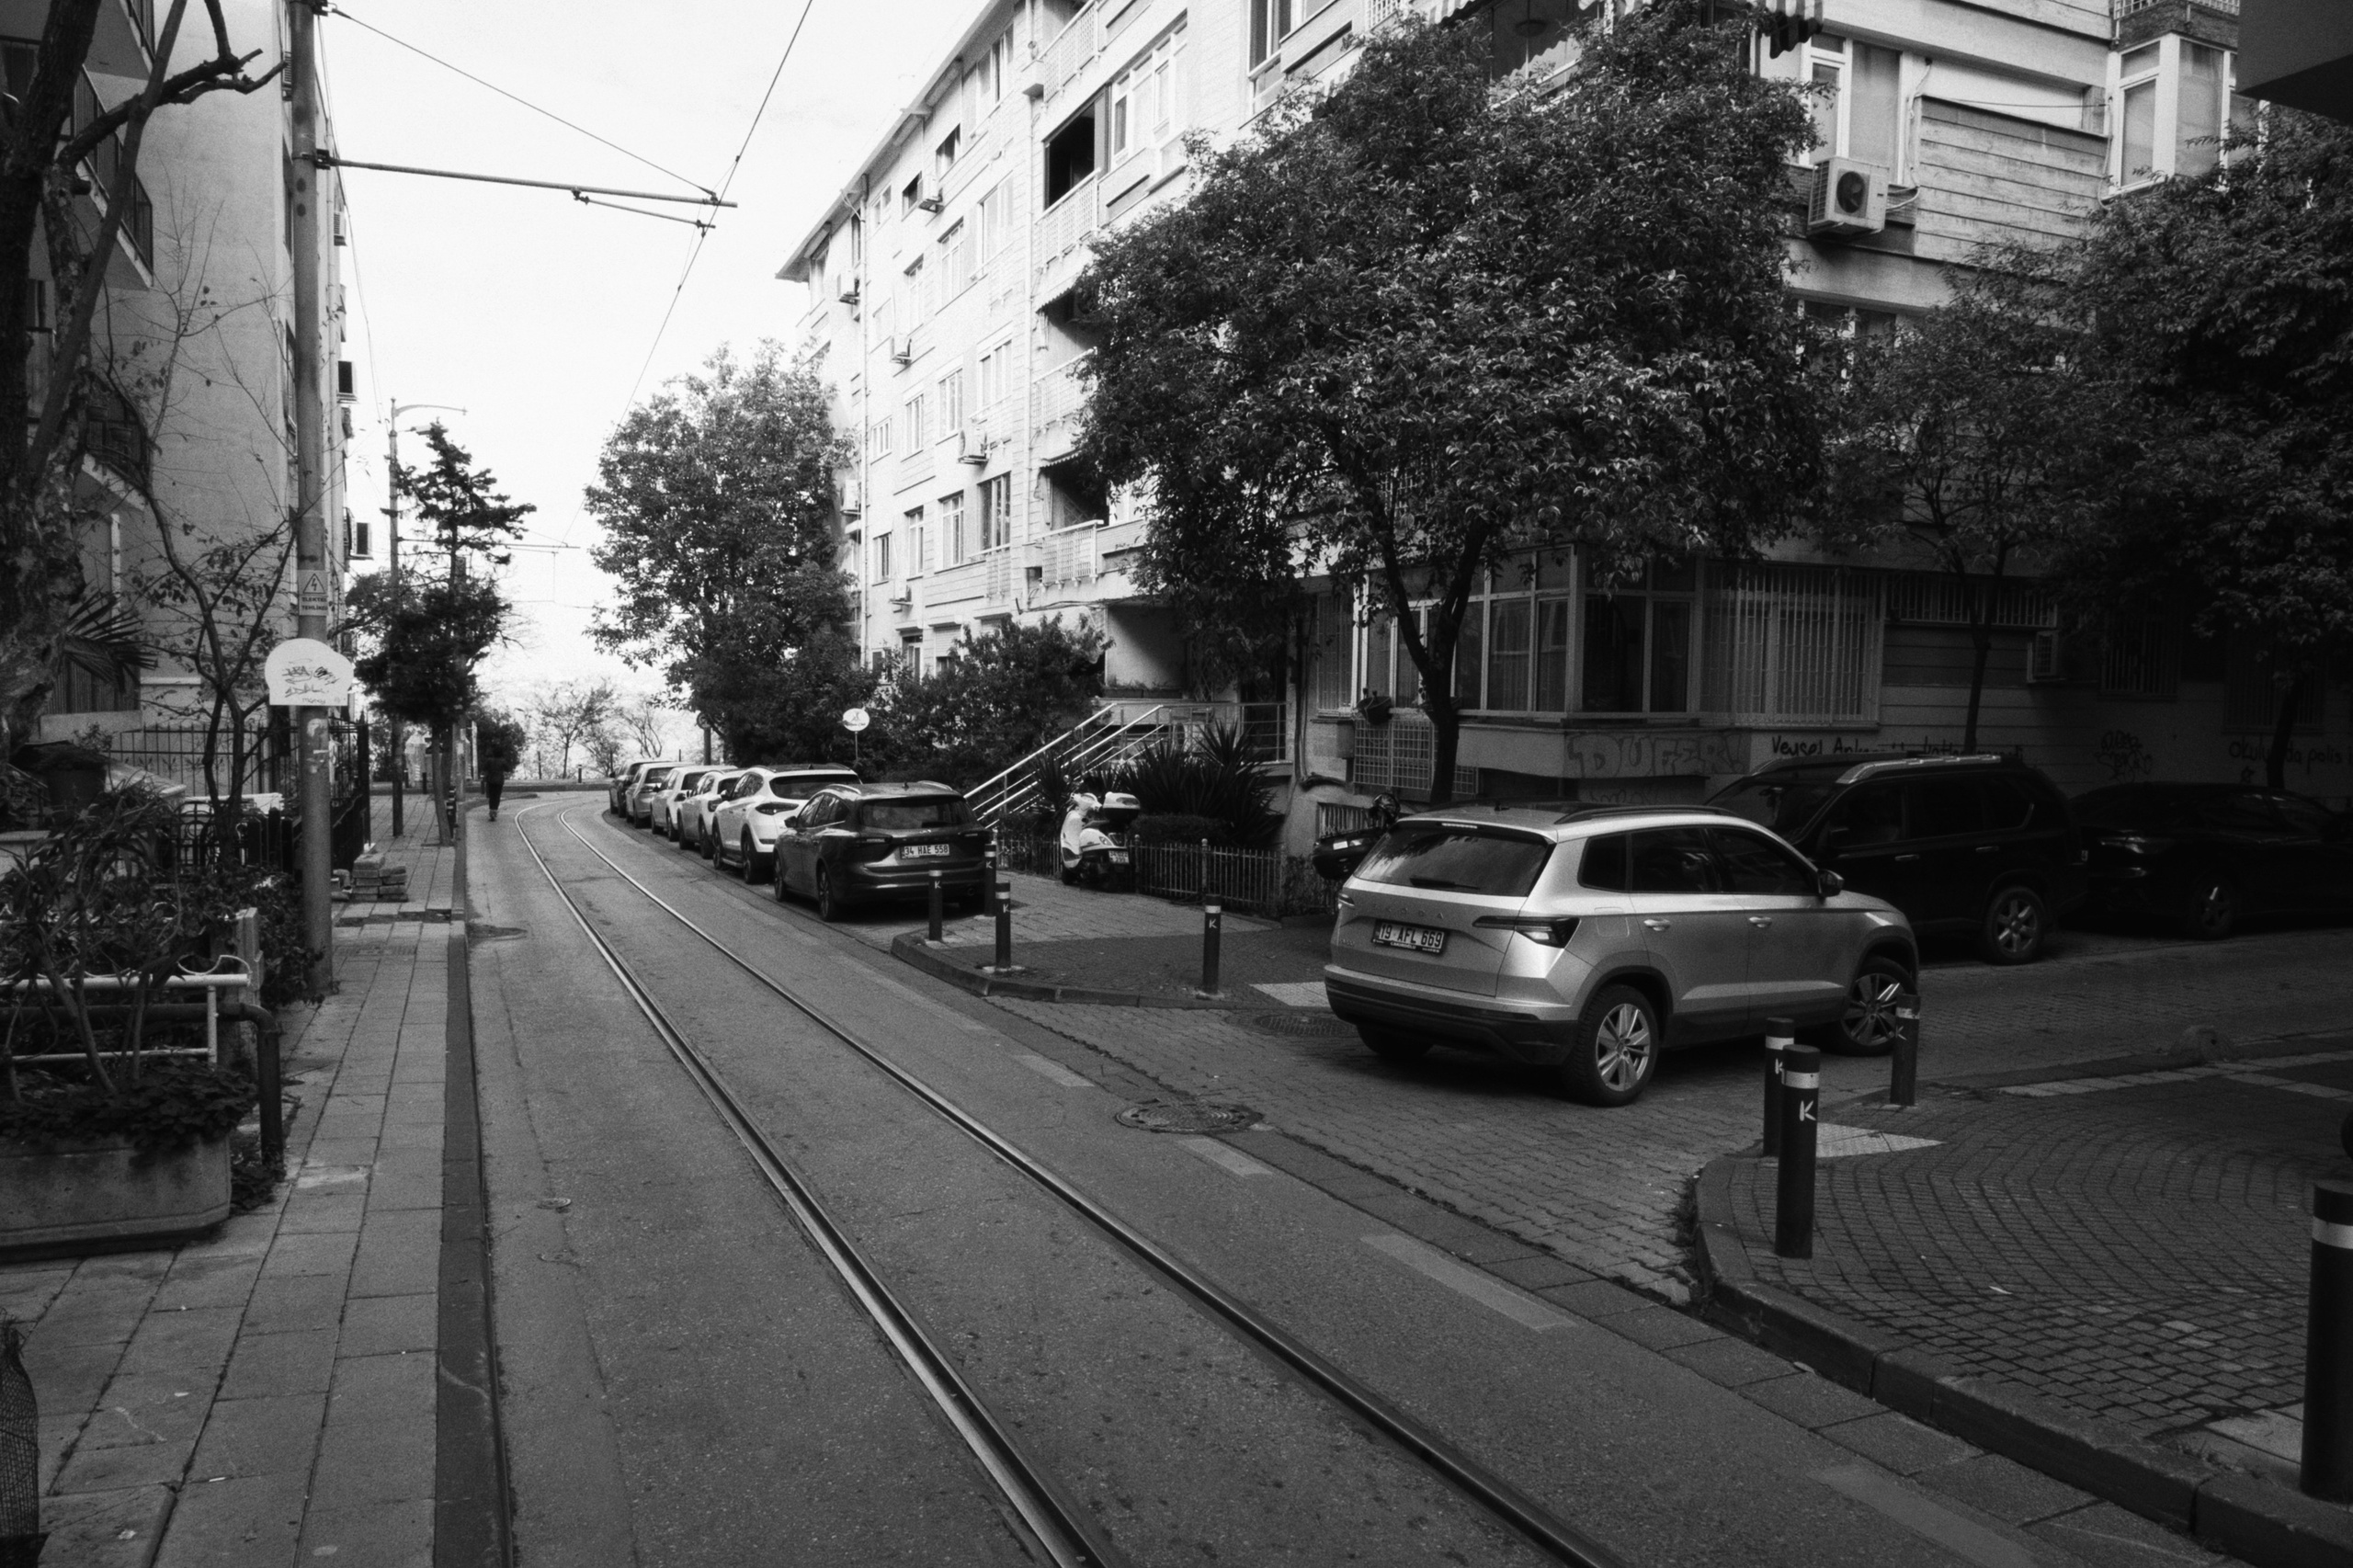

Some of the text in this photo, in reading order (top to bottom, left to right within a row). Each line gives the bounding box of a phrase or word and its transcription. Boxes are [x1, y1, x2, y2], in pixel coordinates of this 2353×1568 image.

[904, 846, 915, 856] 34
[935, 845, 949, 854] 558
[935, 881, 941, 890] K
[1209, 918, 1217, 928] K
[1381, 923, 1443, 948] 19 AFL 669
[1800, 1100, 1816, 1121] K
